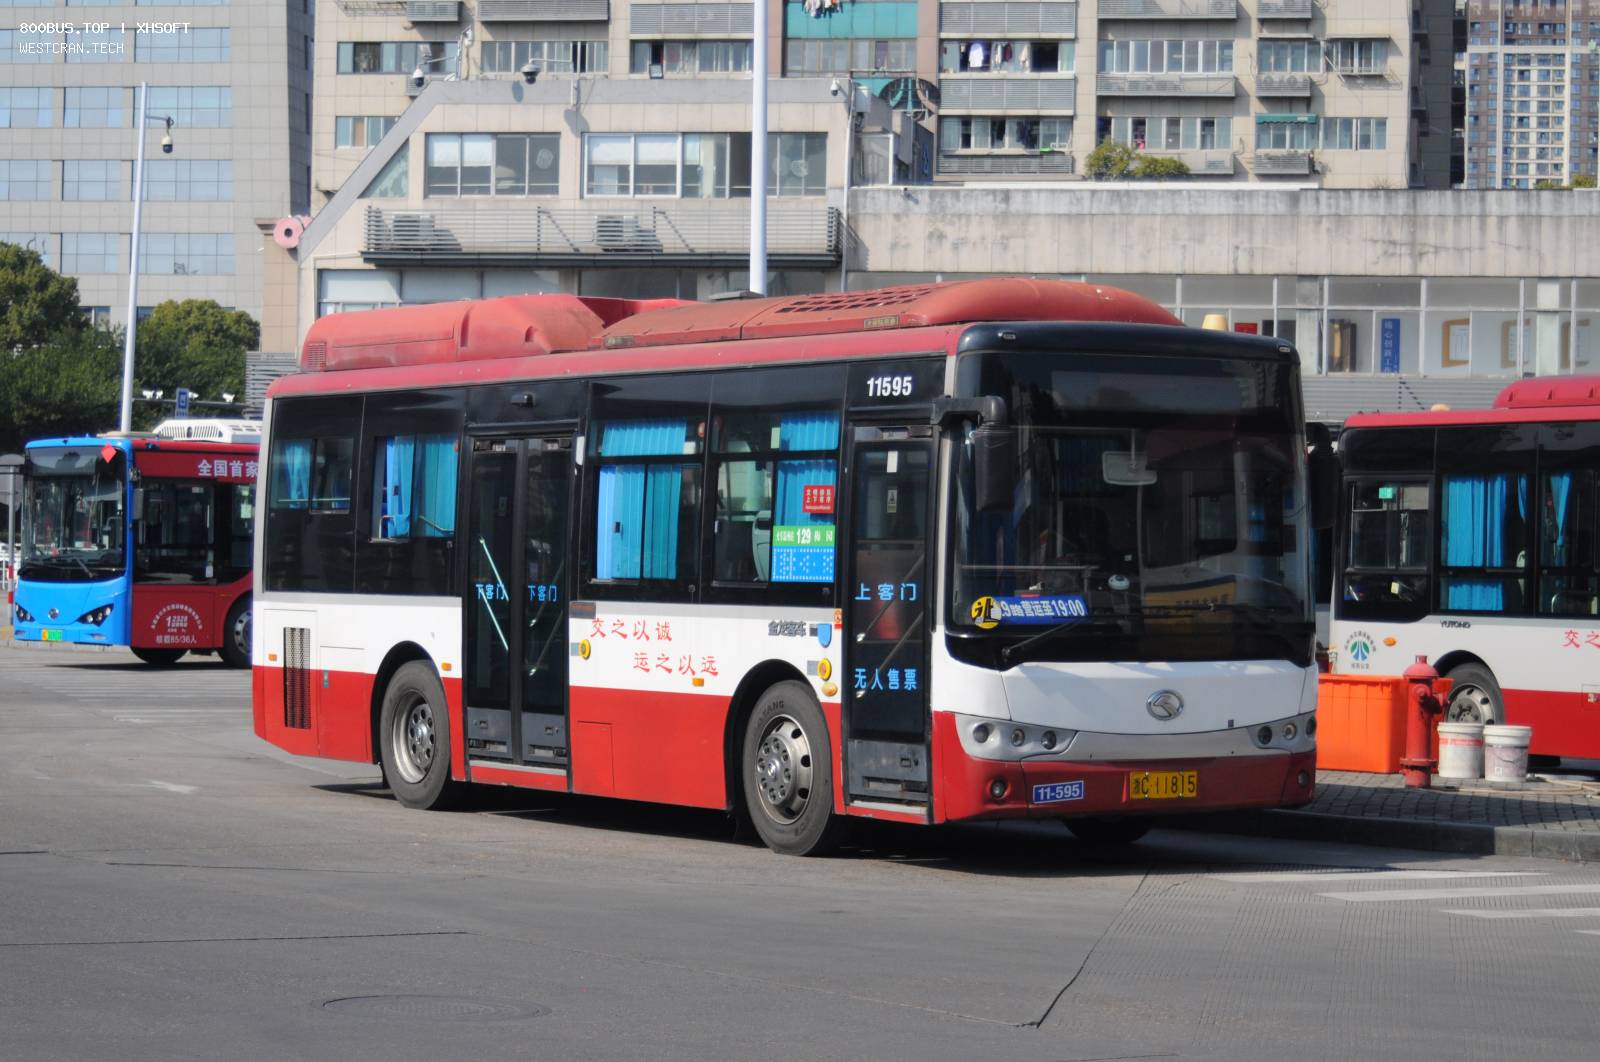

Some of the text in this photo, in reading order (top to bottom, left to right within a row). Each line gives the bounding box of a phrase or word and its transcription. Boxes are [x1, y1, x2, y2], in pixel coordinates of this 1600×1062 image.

[866, 376, 913, 397] 11595
[197, 459, 259, 478] 全国首家
[797, 527, 812, 545] 129
[475, 583, 506, 600] 下客门
[527, 585, 557, 602] 下客门
[854, 582, 917, 601] 上客门
[1000, 599, 1085, 617] 9路营运至19:00
[590, 617, 673, 642] 交之以诚
[633, 651, 719, 677] 运之以远
[854, 667, 918, 691] 无人售票
[1037, 783, 1081, 801] 11-595
